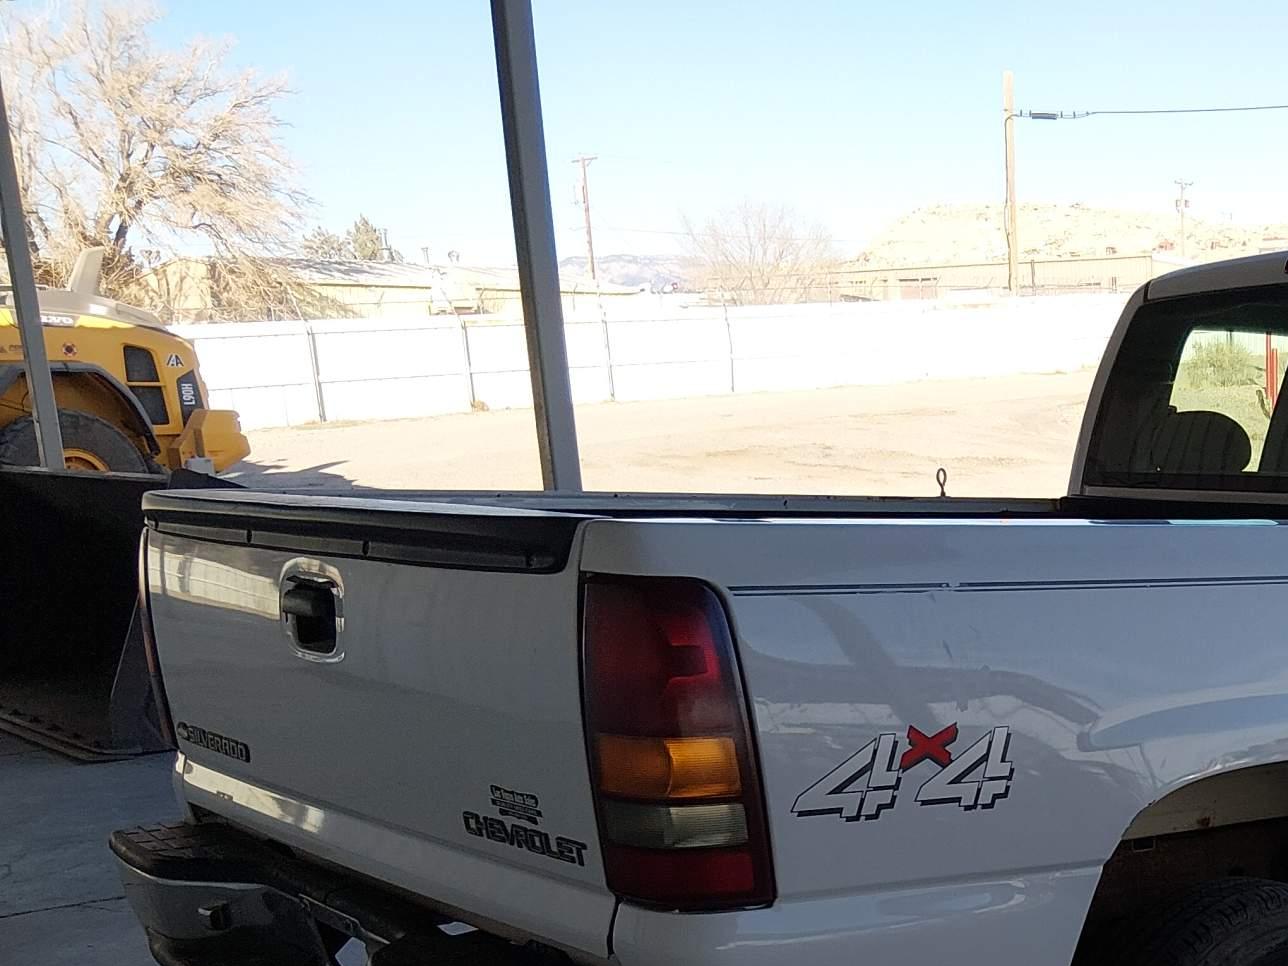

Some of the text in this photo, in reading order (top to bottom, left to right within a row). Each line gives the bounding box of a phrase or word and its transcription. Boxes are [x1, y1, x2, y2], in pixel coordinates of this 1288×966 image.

[180, 383, 196, 405] L90H
[186, 719, 251, 763] SILVERADO
[462, 810, 588, 867] CHEVROLET
